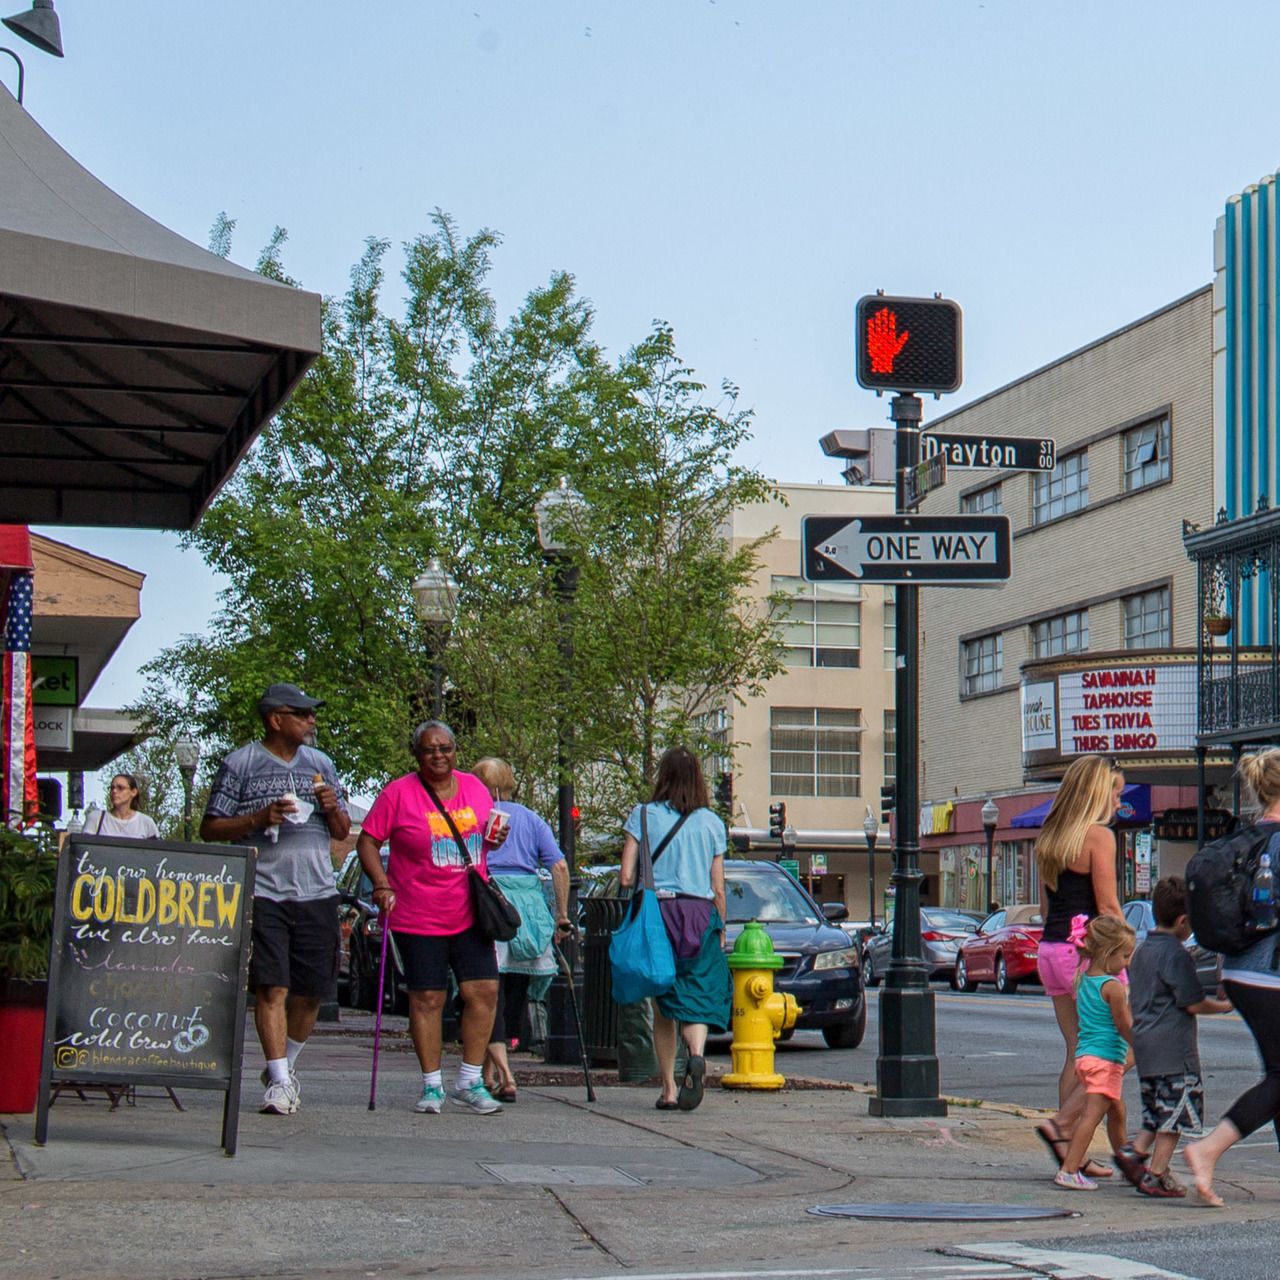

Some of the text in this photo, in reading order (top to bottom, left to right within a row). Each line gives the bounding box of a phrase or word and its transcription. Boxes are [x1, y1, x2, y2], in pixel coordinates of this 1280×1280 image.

[925, 436, 1016, 467] Drayton
[1040, 440, 1053, 454] ST
[867, 536, 988, 561] ONE WAY
[1081, 670, 1156, 689] SAVANNAH
[1083, 691, 1153, 710] TAPHOUSE
[1072, 712, 1153, 731] TUES TRIVIA
[1073, 733, 1157, 751] THURS BINGO
[76, 851, 107, 897] try
[155, 857, 236, 885] homemade
[121, 926, 176, 945] also
[186, 929, 234, 946] have
[90, 1006, 203, 1031] coconut
[54, 1028, 171, 1051] cold brew
